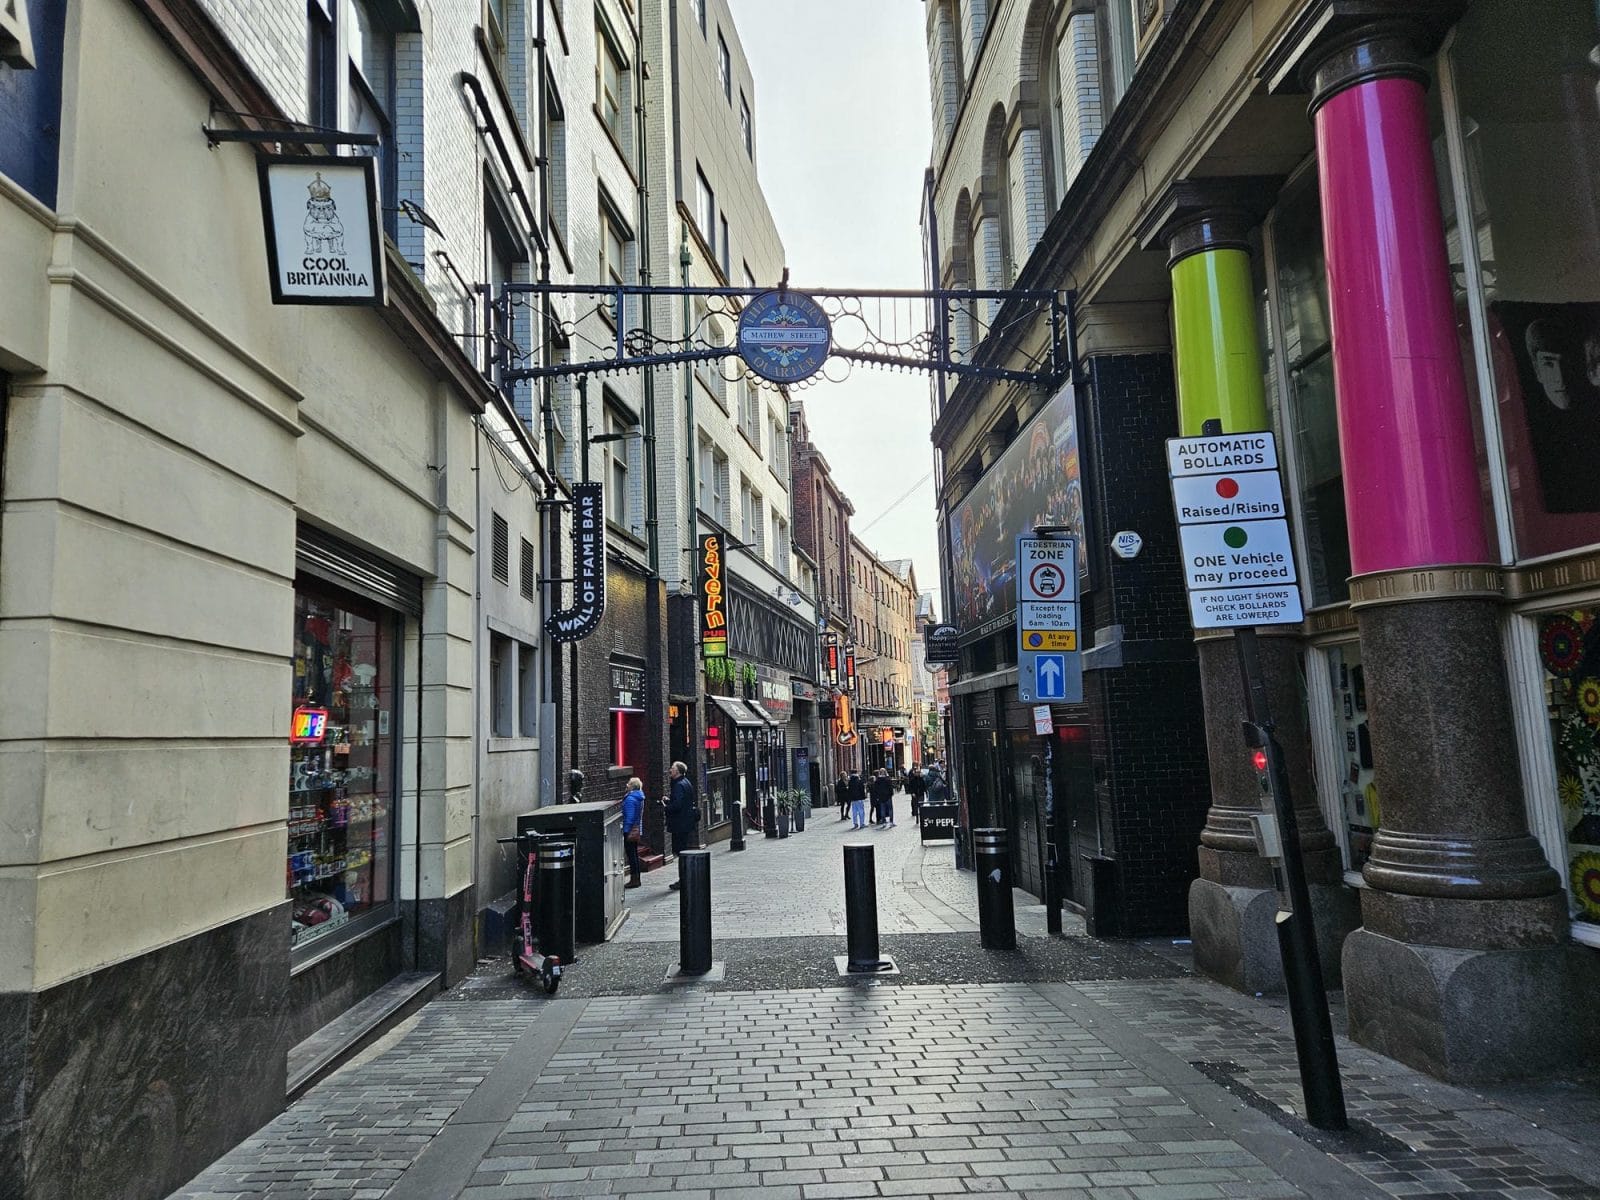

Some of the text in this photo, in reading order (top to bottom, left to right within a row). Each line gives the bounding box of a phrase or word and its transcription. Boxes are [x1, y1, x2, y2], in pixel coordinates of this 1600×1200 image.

[303, 258, 349, 271] COOL
[287, 272, 368, 286] BRITANNIA
[744, 299, 769, 325] THE
[753, 357, 816, 377] QUARTER
[1178, 438, 1266, 455] AUTOMATIC
[1184, 453, 1264, 469] BOLLARDS
[1182, 502, 1280, 518] Raised/Rising
[1118, 535, 1134, 543] NIS
[1030, 550, 1064, 560] ZONE
[1194, 552, 1284, 567] ONE Vehicle
[558, 496, 594, 632] WALL OF FAME BAR
[1194, 566, 1288, 584] may proceed
[1200, 591, 1288, 603] IF NO LIGHT SHOWS
[1030, 605, 1054, 613] Except
[1206, 601, 1286, 612] CHECK BOLLARDS
[1036, 612, 1062, 620] loading
[1216, 611, 1280, 621] ARE LOWERED
